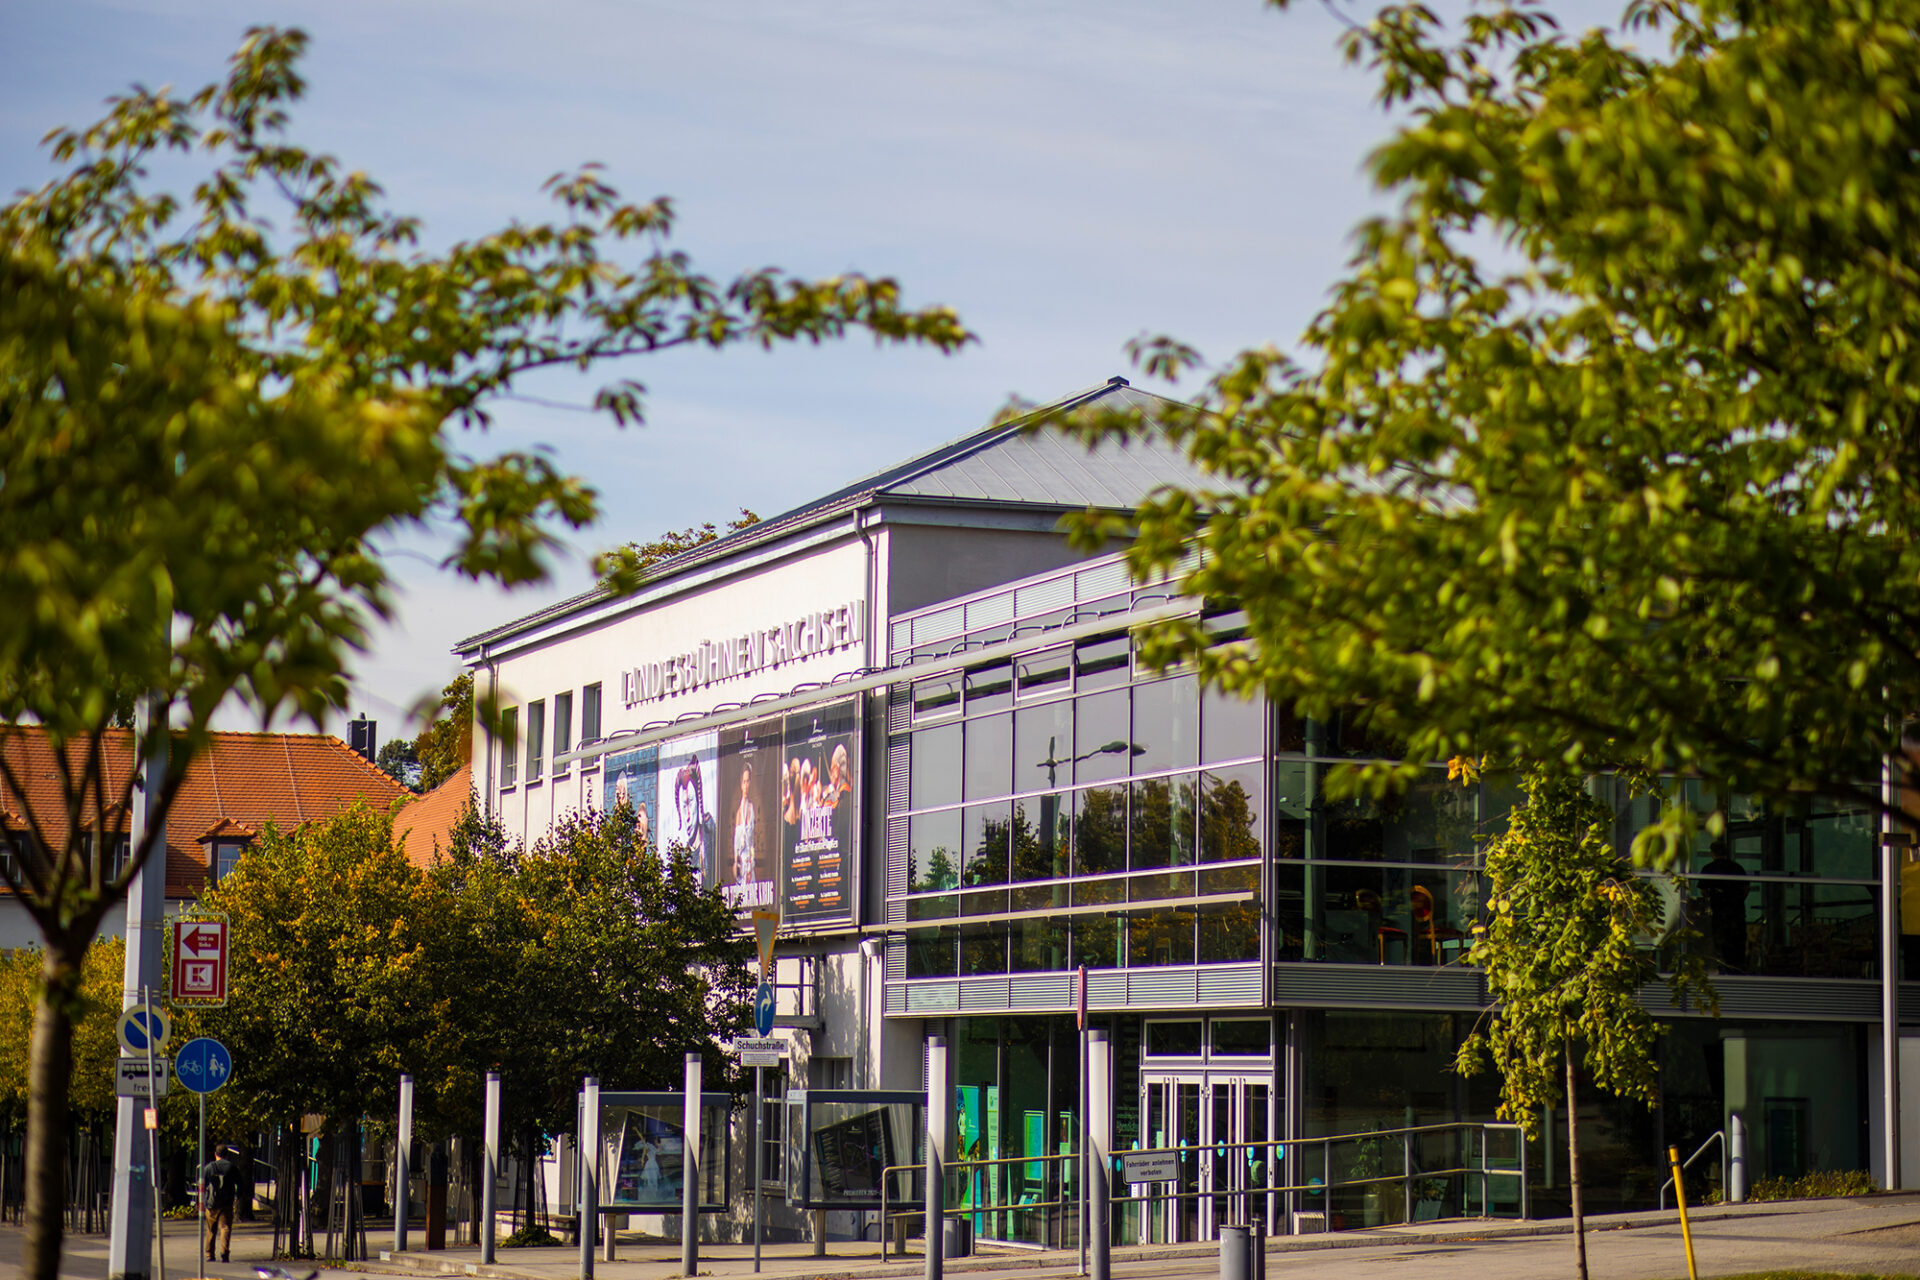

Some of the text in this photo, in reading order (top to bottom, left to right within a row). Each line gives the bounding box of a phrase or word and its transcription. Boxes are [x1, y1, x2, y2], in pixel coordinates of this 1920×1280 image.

[621, 599, 864, 706] LANDESBÜHNEN SACHSEN
[737, 1040, 785, 1050] Schuchstraße
